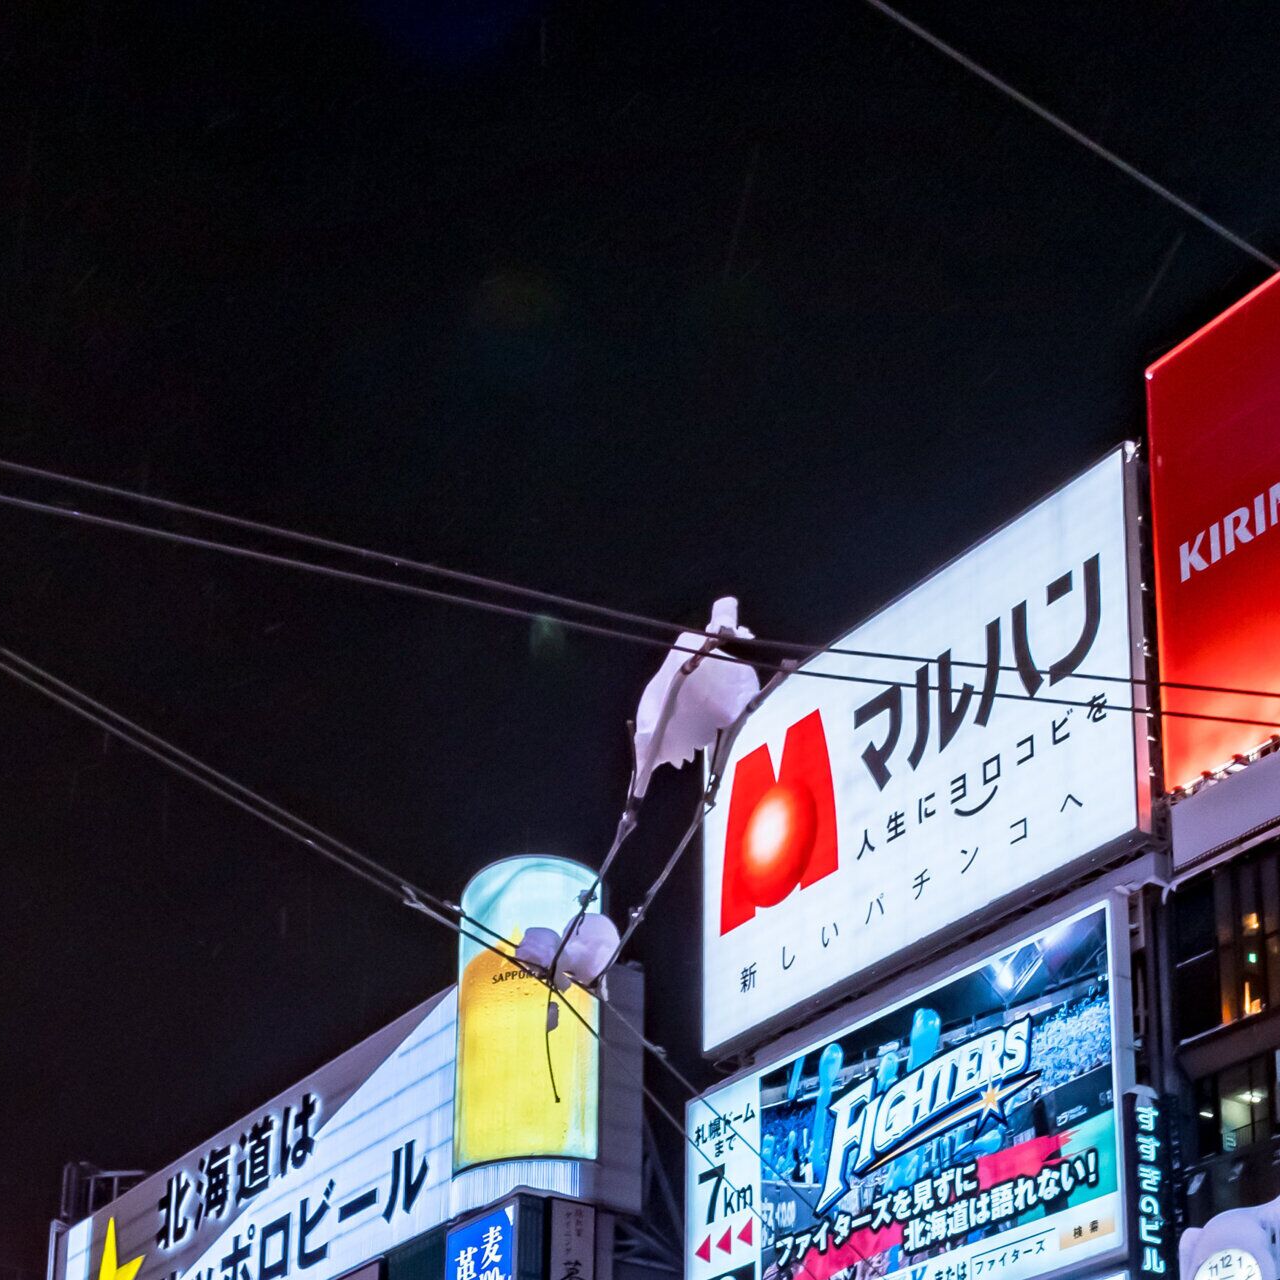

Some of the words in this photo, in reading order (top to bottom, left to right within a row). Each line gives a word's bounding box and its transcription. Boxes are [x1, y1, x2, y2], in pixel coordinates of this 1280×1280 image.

[853, 552, 1101, 792] マルハン
[856, 693, 1108, 861] 人生にヨロコビを
[740, 793, 1084, 994] 新しいパチンコへ
[492, 968, 538, 984] SAPPO
[694, 1104, 755, 1146] 札幌ドーム
[715, 1135, 736, 1158] まで
[816, 1014, 1035, 1216] FIGHTERS
[157, 1092, 320, 1250] 北海道は
[775, 1162, 977, 1268] ファイターズを見ずに
[1134, 1105, 1166, 1275] すすきのビル
[974, 1239, 1047, 1271] ファイターズ
[1220, 1254, 1232, 1268] 12
[1237, 1257, 1243, 1269] 1
